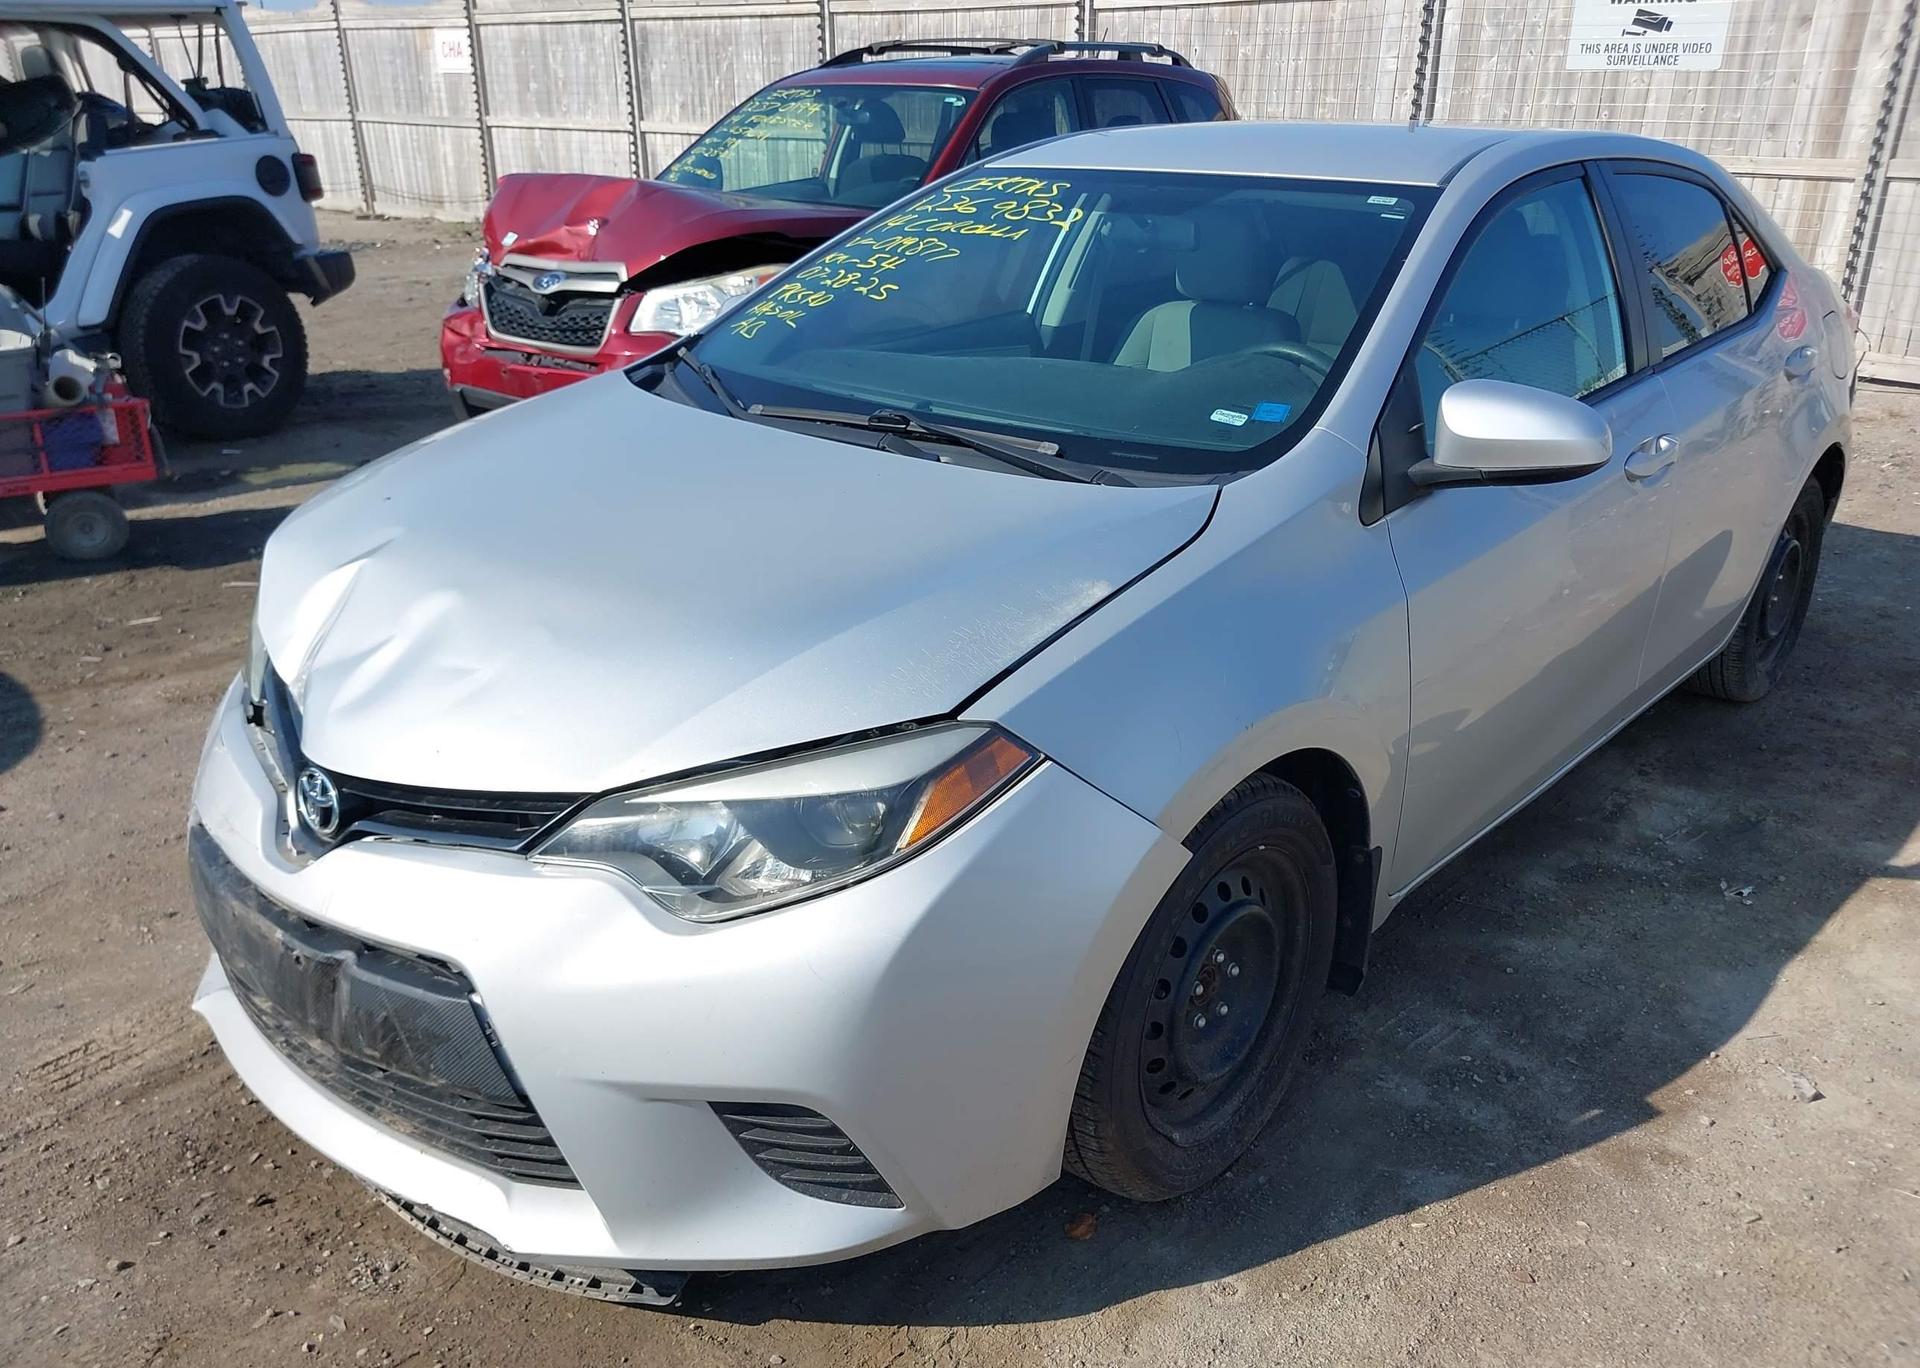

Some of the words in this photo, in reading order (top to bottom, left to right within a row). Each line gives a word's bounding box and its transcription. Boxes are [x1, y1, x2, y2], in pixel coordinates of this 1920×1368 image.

[1579, 43, 1601, 54] THIS
[1603, 43, 1629, 54] AREA
[1631, 43, 1642, 54] IS
[1644, 43, 1679, 54] UNDER
[1682, 42, 1713, 54] VIDEO
[1606, 55, 1680, 66] SURVEILLANCE
